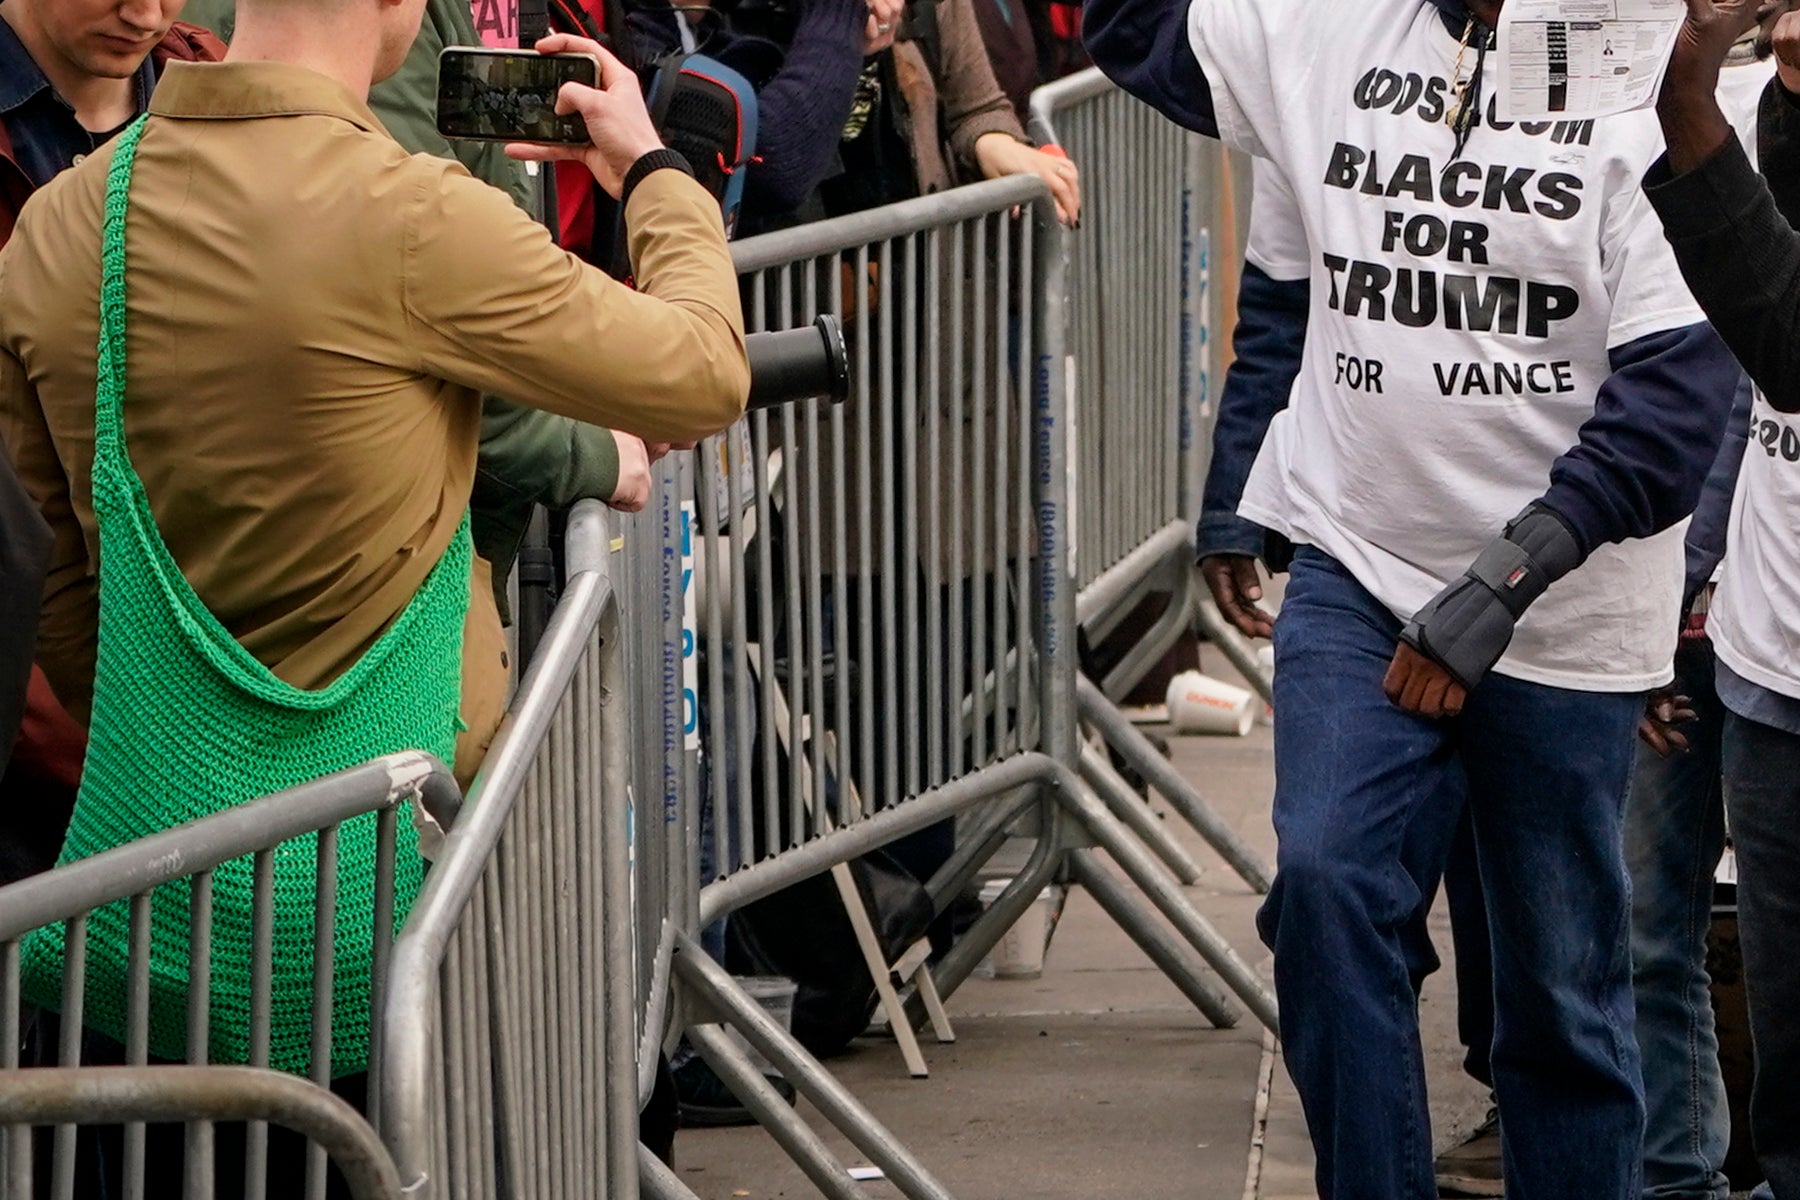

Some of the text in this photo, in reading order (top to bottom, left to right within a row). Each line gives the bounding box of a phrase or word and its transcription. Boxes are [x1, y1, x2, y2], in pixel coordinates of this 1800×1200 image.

[1323, 141, 1584, 221] BLACKS
[1381, 210, 1490, 265] FOR
[1322, 251, 1580, 339] TRUMP
[1334, 351, 1576, 397] FOR VANCE
